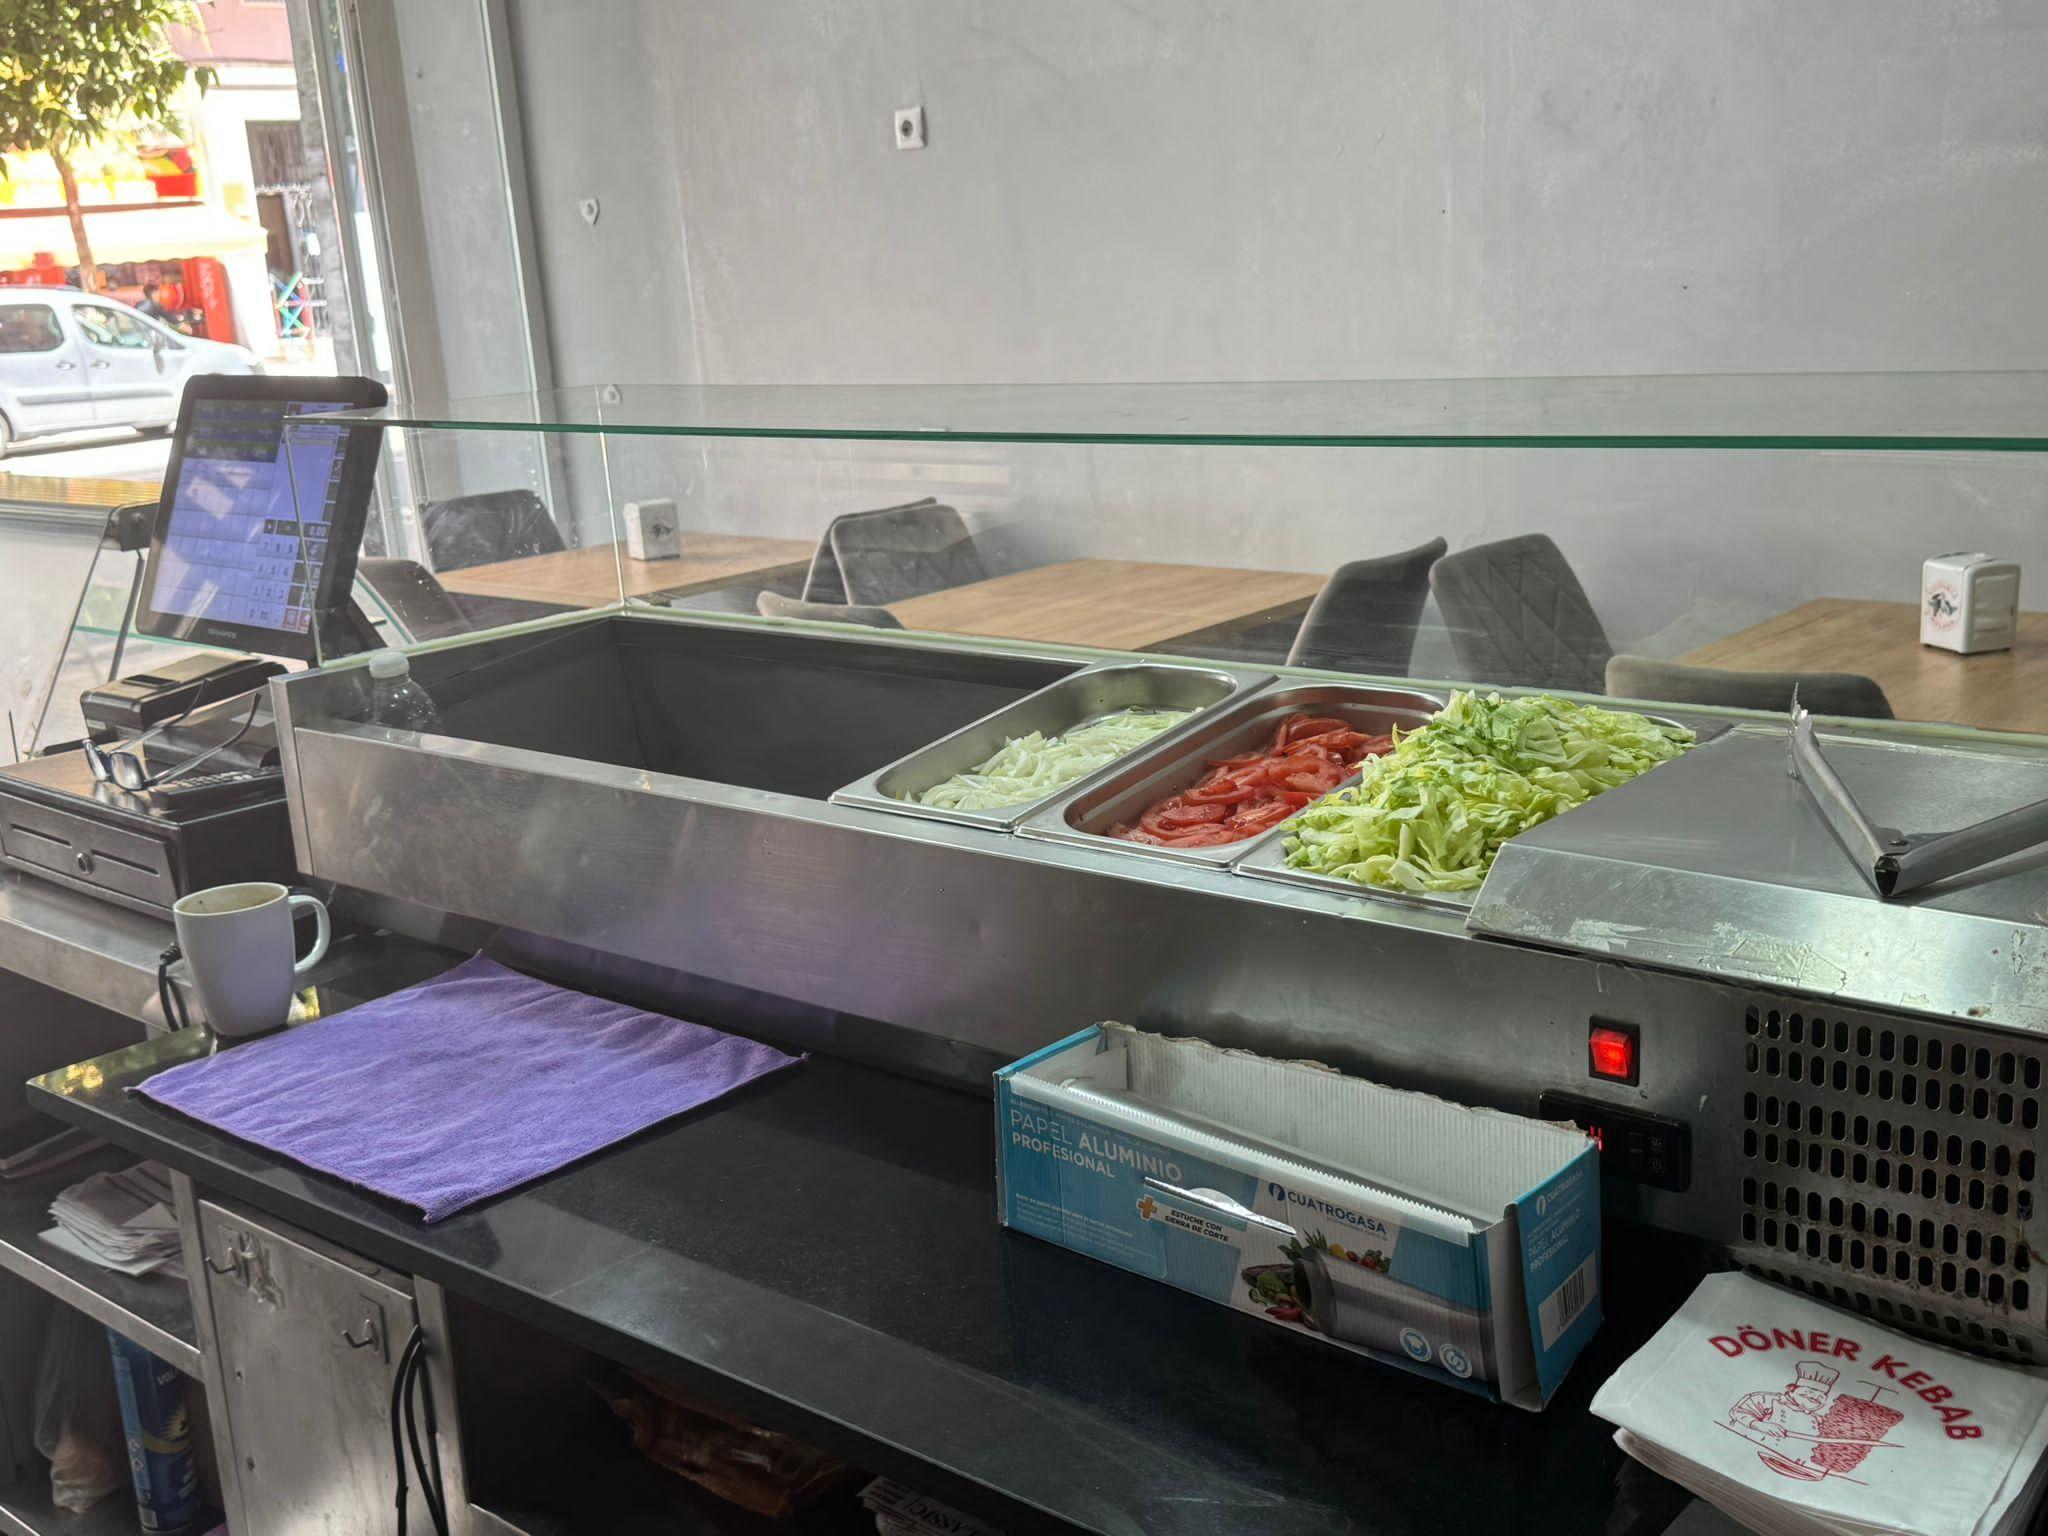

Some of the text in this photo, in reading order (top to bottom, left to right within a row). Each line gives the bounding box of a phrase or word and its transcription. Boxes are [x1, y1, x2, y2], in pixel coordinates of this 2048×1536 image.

[1010, 1109, 1072, 1145] PAPEL
[1079, 1132, 1183, 1182] ALUMINIO
[1011, 1131, 1116, 1179] PROFESIONAL
[1165, 1215, 1229, 1242] SIERRA DE CORTE
[1171, 1209, 1223, 1232] ESTUCHE CON
[1287, 1190, 1387, 1235] CUATROGASA
[1709, 1325, 1984, 1440] DÖNER KEBAB
